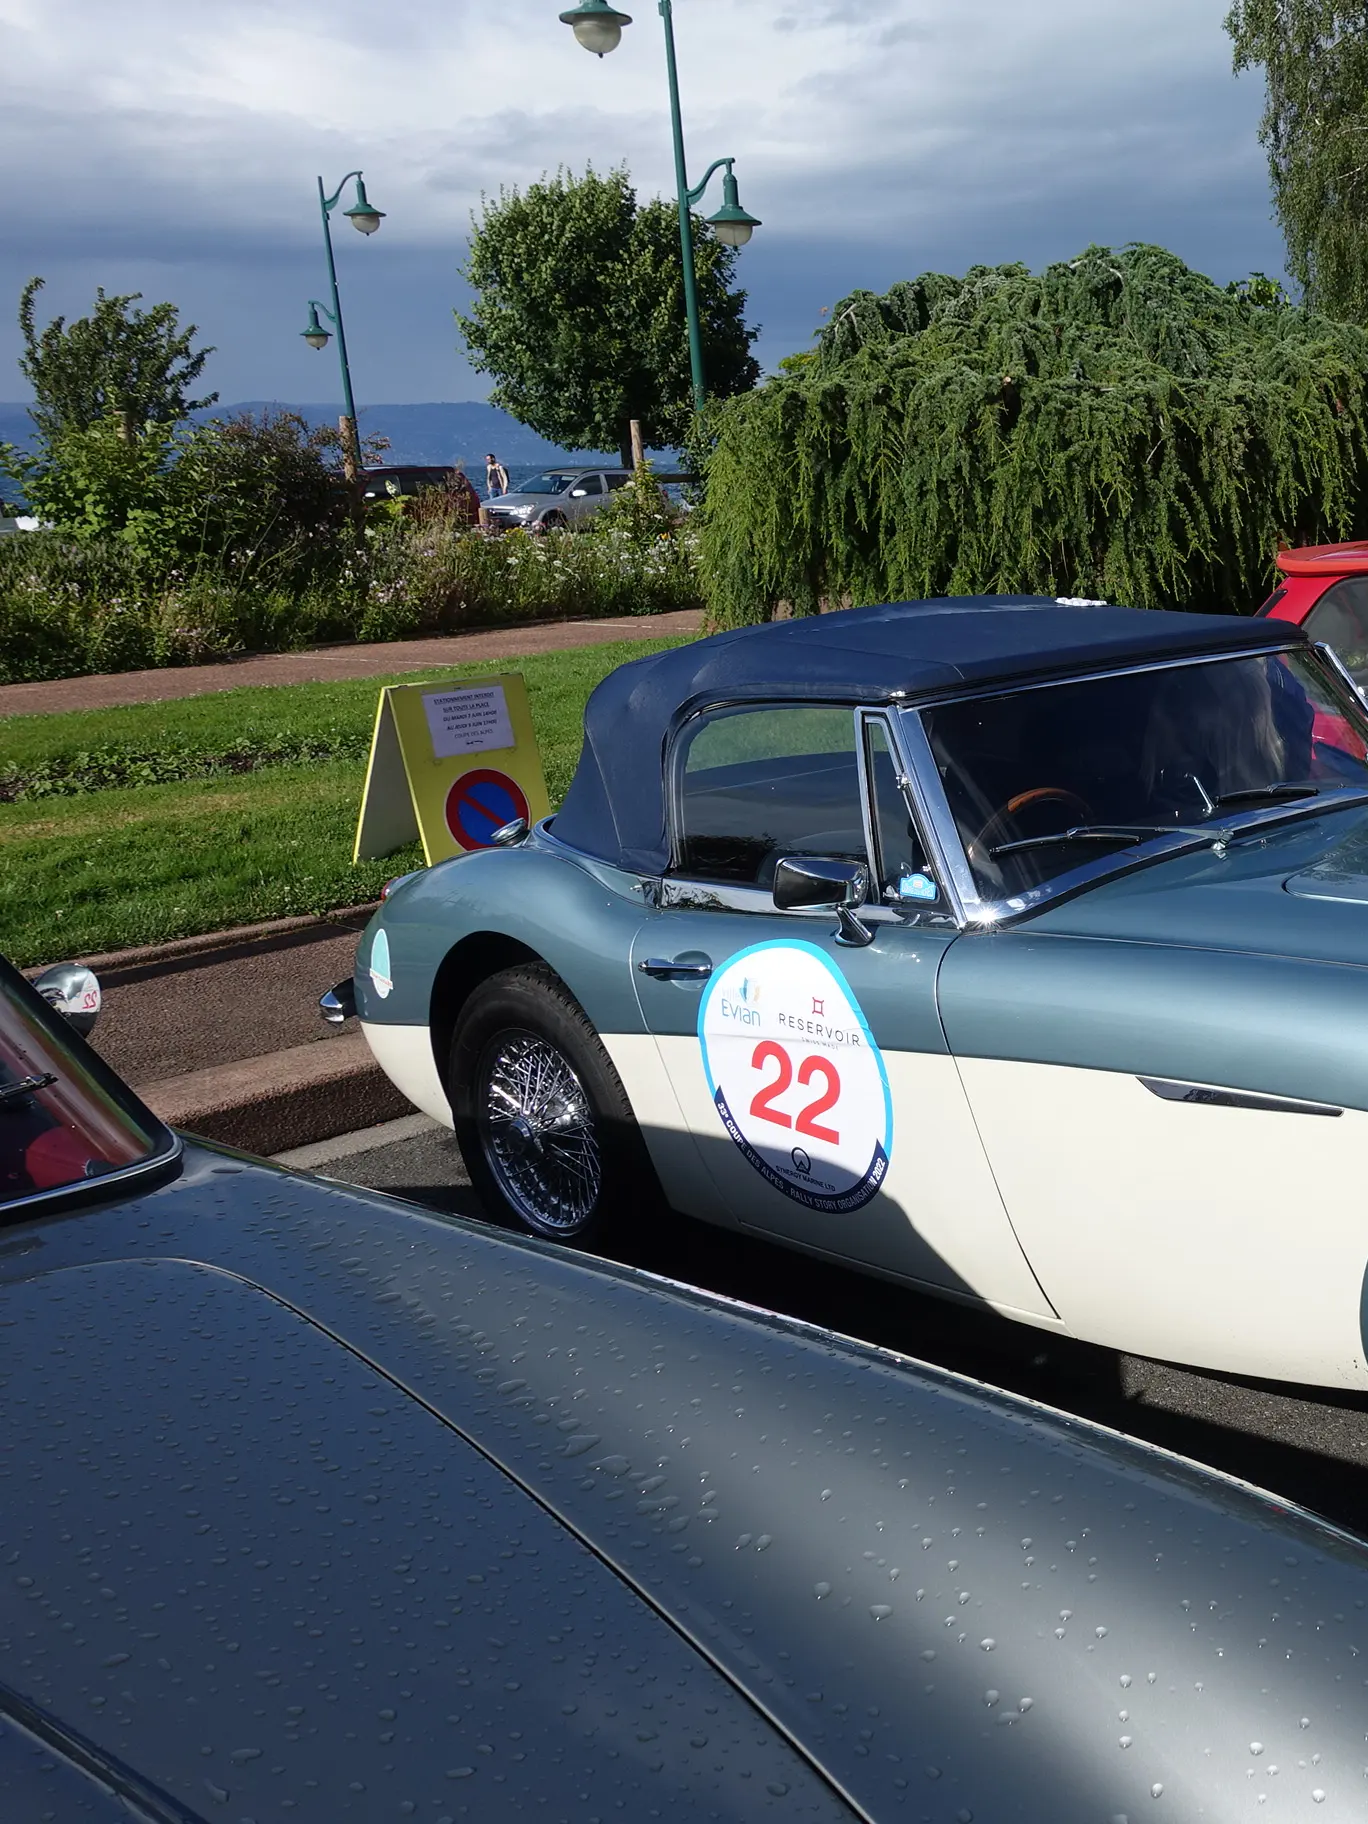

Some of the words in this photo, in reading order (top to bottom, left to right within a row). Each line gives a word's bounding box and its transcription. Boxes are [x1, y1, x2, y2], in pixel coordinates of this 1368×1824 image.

[434, 694, 473, 705] STATIONNEMENT
[474, 692, 494, 700] INTERDIT
[475, 701, 490, 709] PLACE
[451, 713, 468, 721] MARDI
[778, 1012, 861, 1047] RESERVOIR
[750, 1040, 841, 1146] 22
[726, 1119, 748, 1152] COUPE
[746, 1149, 761, 1168] DES
[760, 1165, 785, 1190] ALPES
[790, 1187, 814, 1206] RALLY
[815, 1199, 838, 1211] STORY
[837, 1175, 879, 1210] ORGANISATION
[872, 1157, 887, 1181] 2022
[775, 1164, 802, 1180] SYNERGY
[802, 1174, 824, 1189] MARINE
[823, 1182, 836, 1192] LTD
